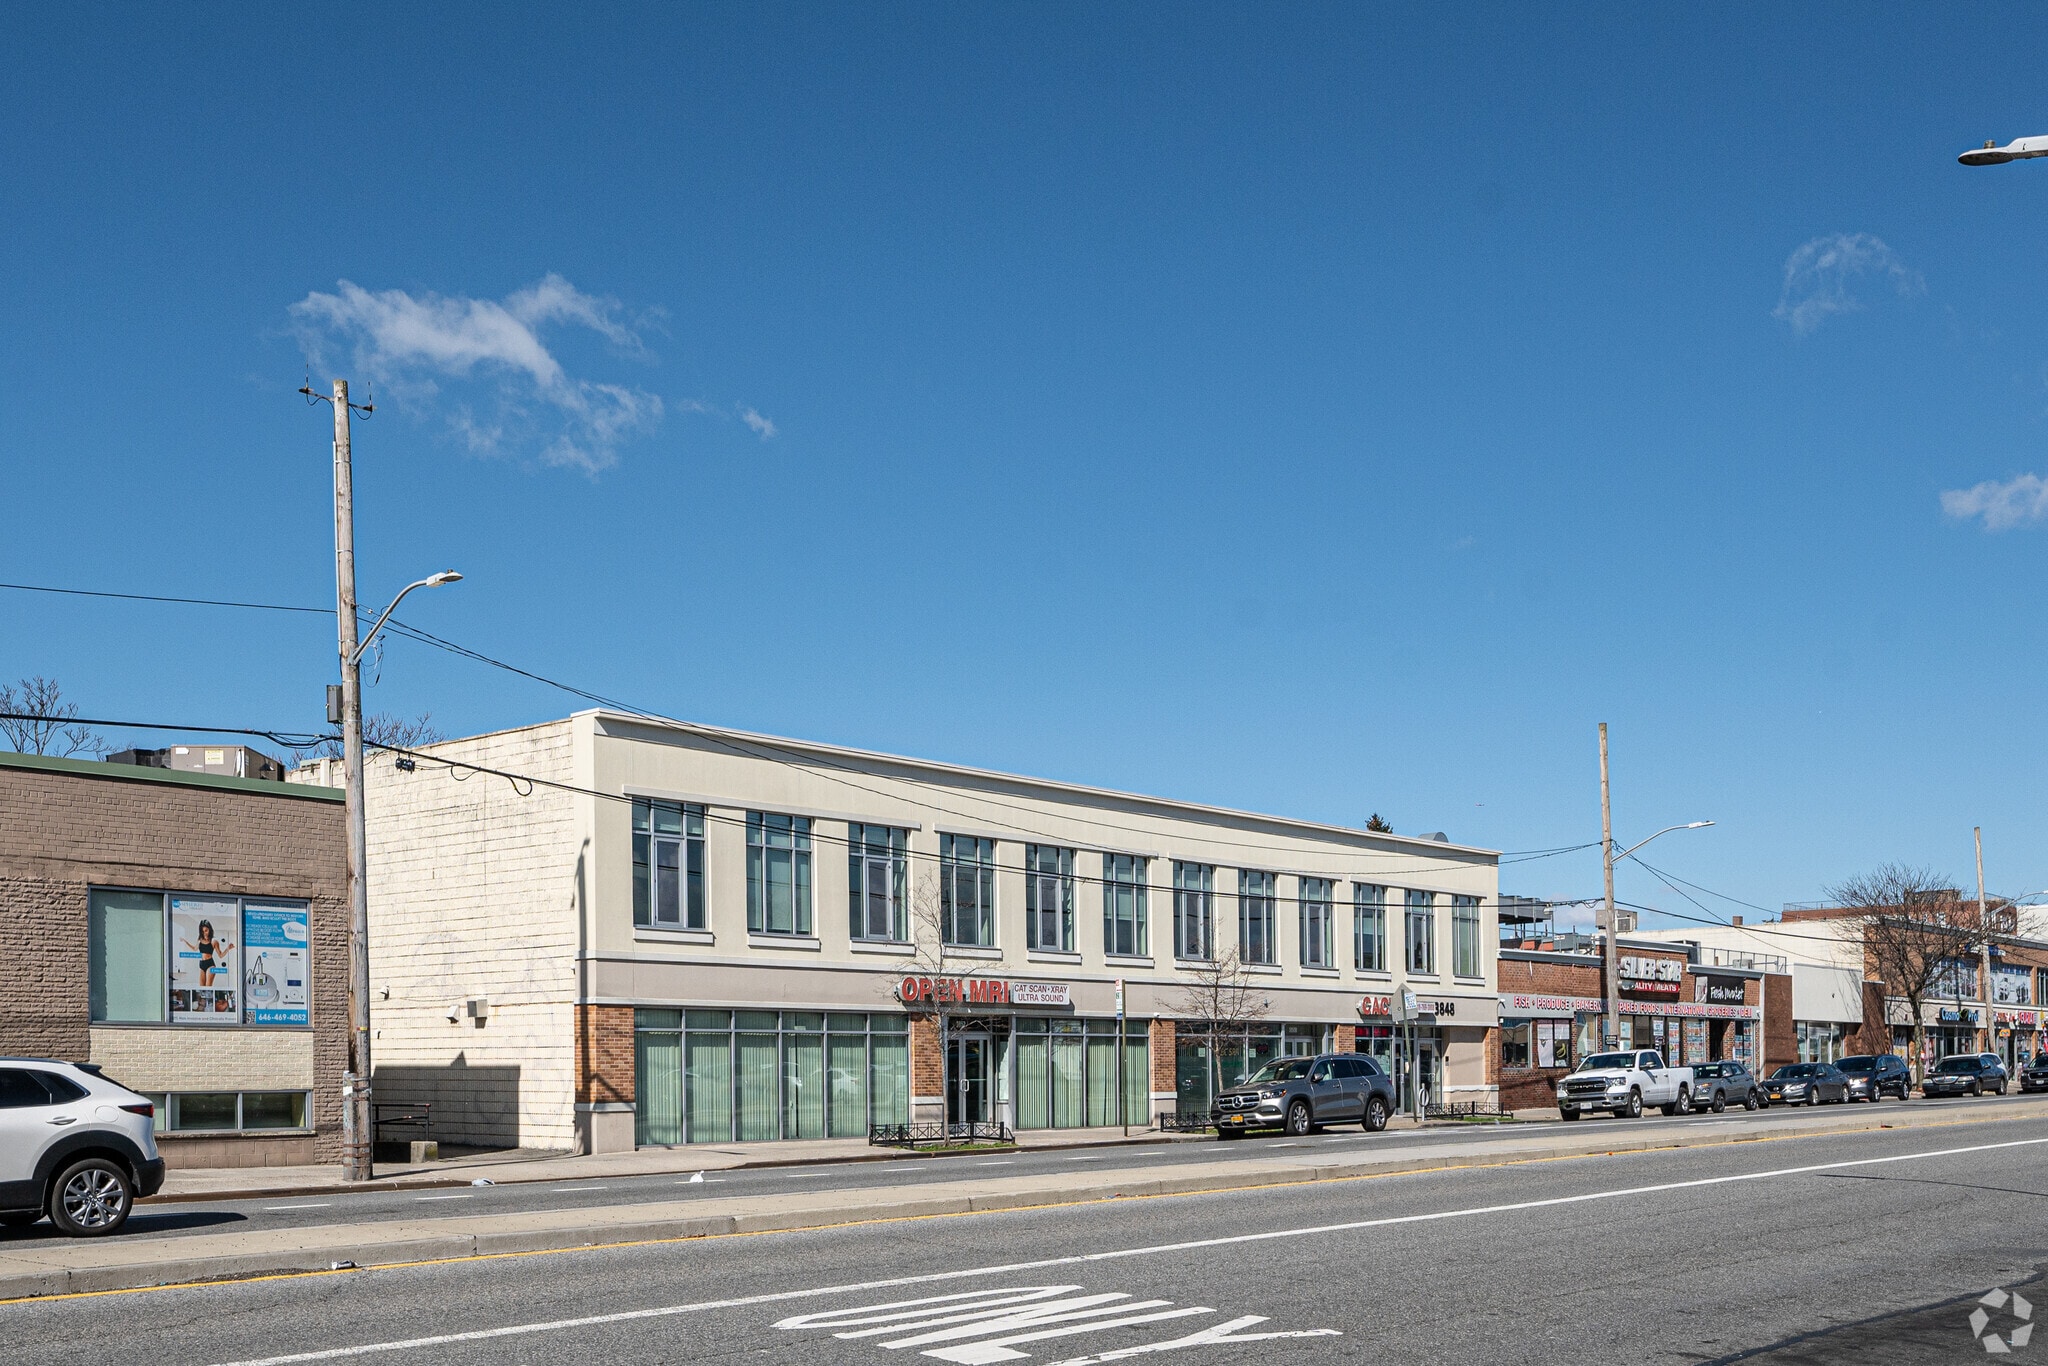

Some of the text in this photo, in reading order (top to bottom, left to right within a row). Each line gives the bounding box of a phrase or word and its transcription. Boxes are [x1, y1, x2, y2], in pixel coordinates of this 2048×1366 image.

[901, 976, 1009, 1003] OPEN MRI
[1014, 984, 1027, 993] CAT
[1018, 993, 1064, 1002] ULTRA SOUND
[1513, 996, 1530, 1008] FISH
[1536, 997, 1570, 1010] PRODUCE
[1640, 1002, 1659, 1014] FOODS
[1663, 1004, 1706, 1016] INTERNATIONAL
[1434, 1001, 1455, 1016] 3848
[769, 1284, 1344, 1366] ONLY
